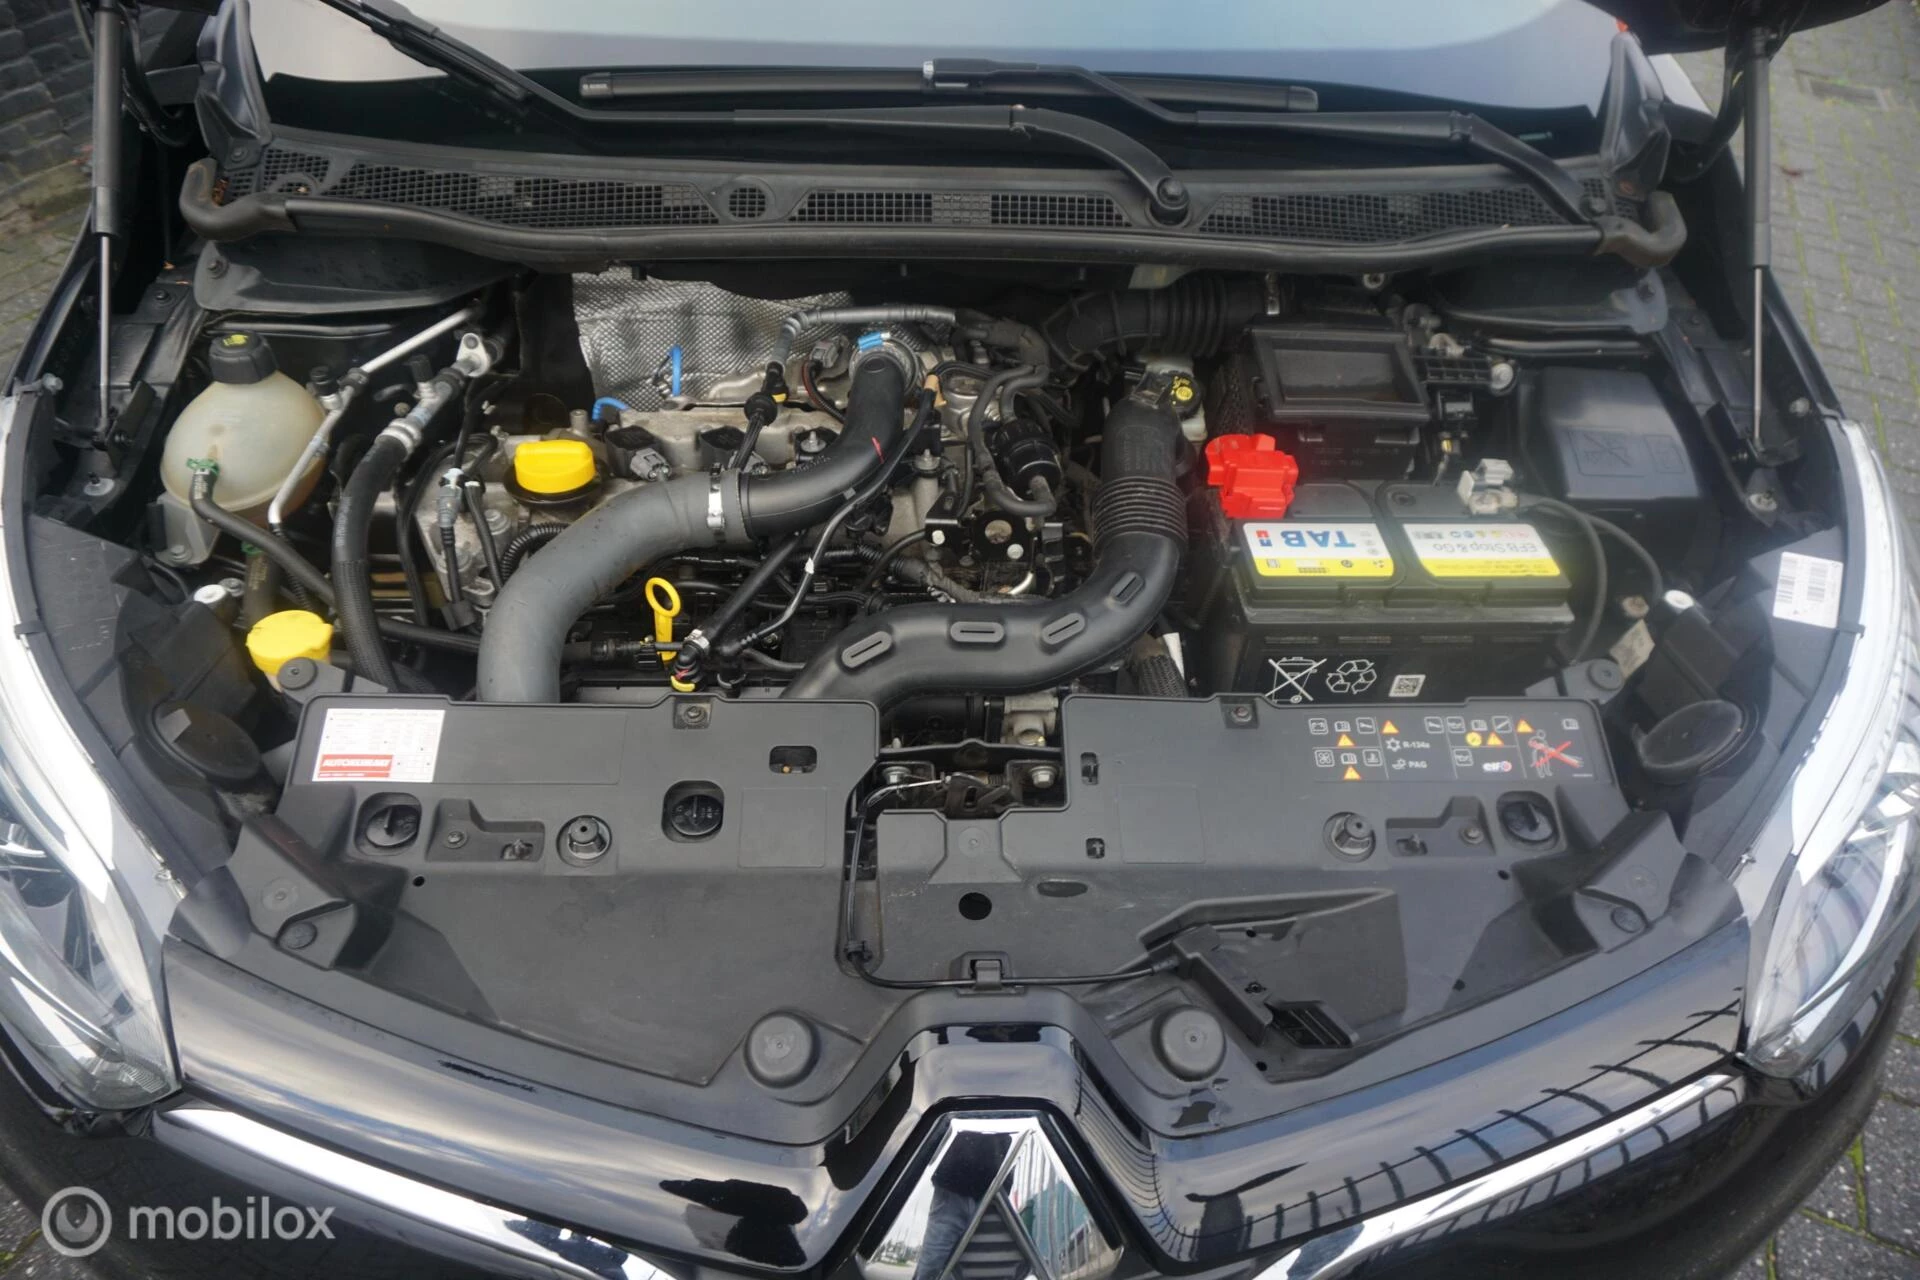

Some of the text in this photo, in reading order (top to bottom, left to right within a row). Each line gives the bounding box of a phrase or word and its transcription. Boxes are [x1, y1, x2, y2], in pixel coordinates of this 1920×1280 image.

[1280, 530, 1356, 548] TAB
[1432, 542, 1456, 553] Go
[1469, 541, 1507, 553] Stop
[1402, 740, 1431, 749] R-134a
[1408, 760, 1428, 769] PAG
